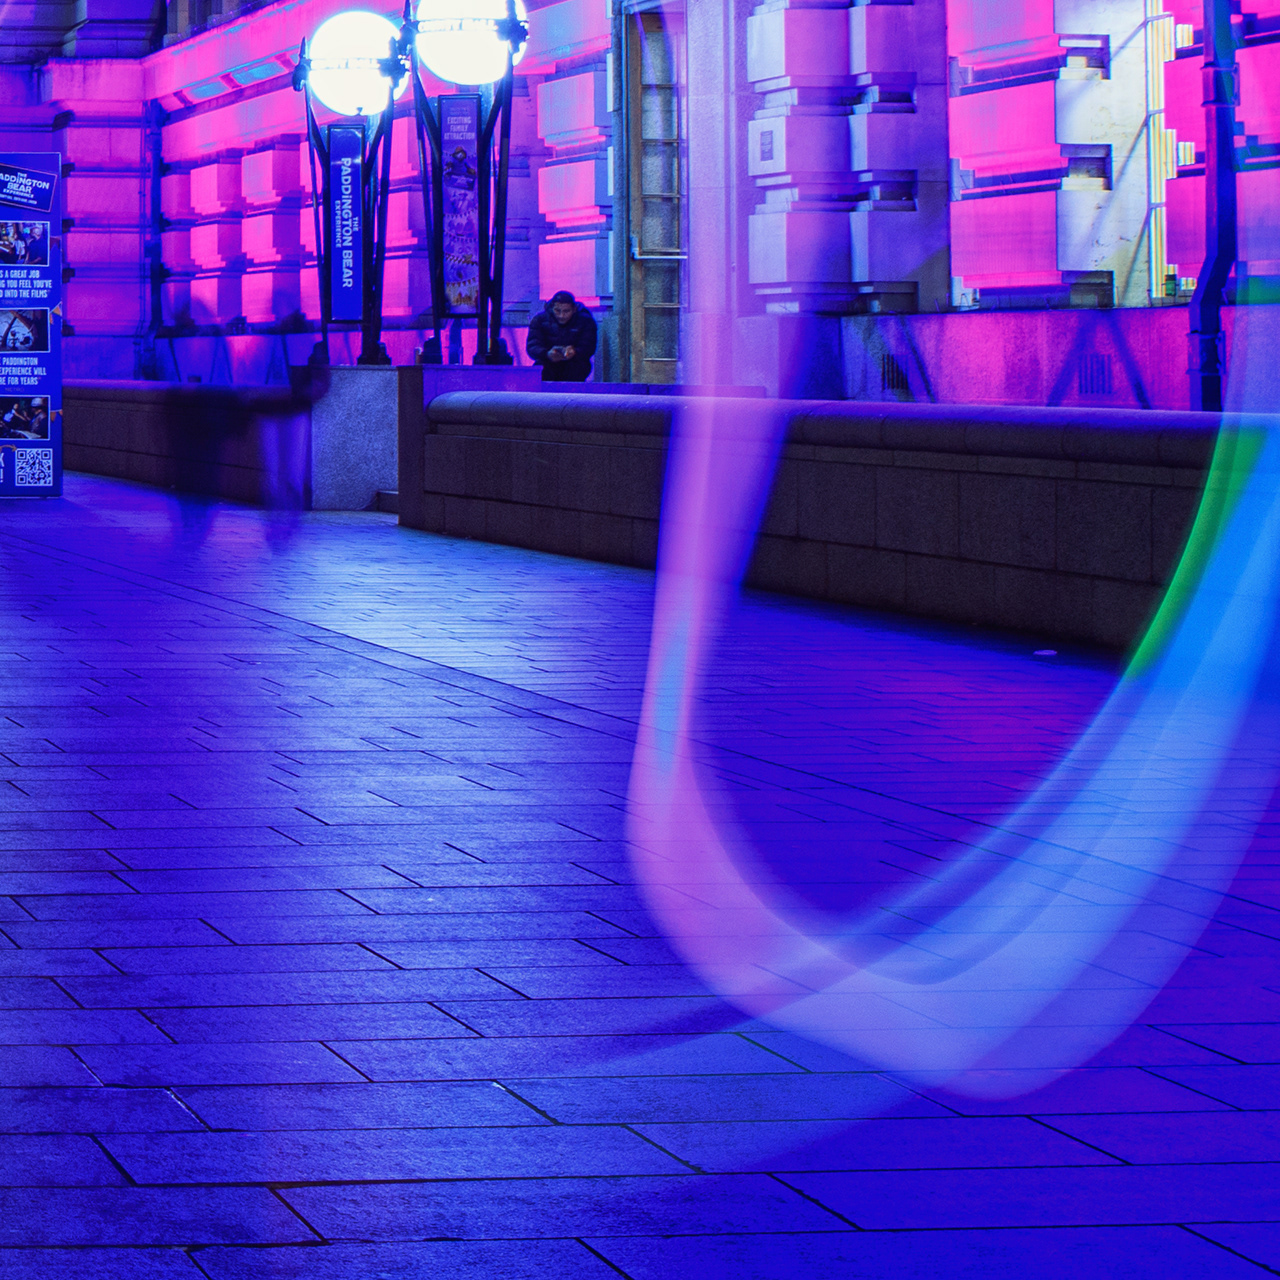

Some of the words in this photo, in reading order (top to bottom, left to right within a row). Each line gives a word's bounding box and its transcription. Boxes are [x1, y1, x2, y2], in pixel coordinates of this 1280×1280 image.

[7, 182, 32, 194] BEAR
[334, 200, 342, 248] EXPERIENCE
[342, 249, 353, 288] BEAR
[28, 269, 40, 278] JOB
[6, 279, 18, 288] YOU
[18, 279, 32, 288] FEEL
[4, 289, 18, 298] INTO
[19, 289, 30, 298] THE
[2, 357, 38, 366] PADDINGTON
[33, 367, 47, 376] WILL
[7, 376, 19, 385] FOR
